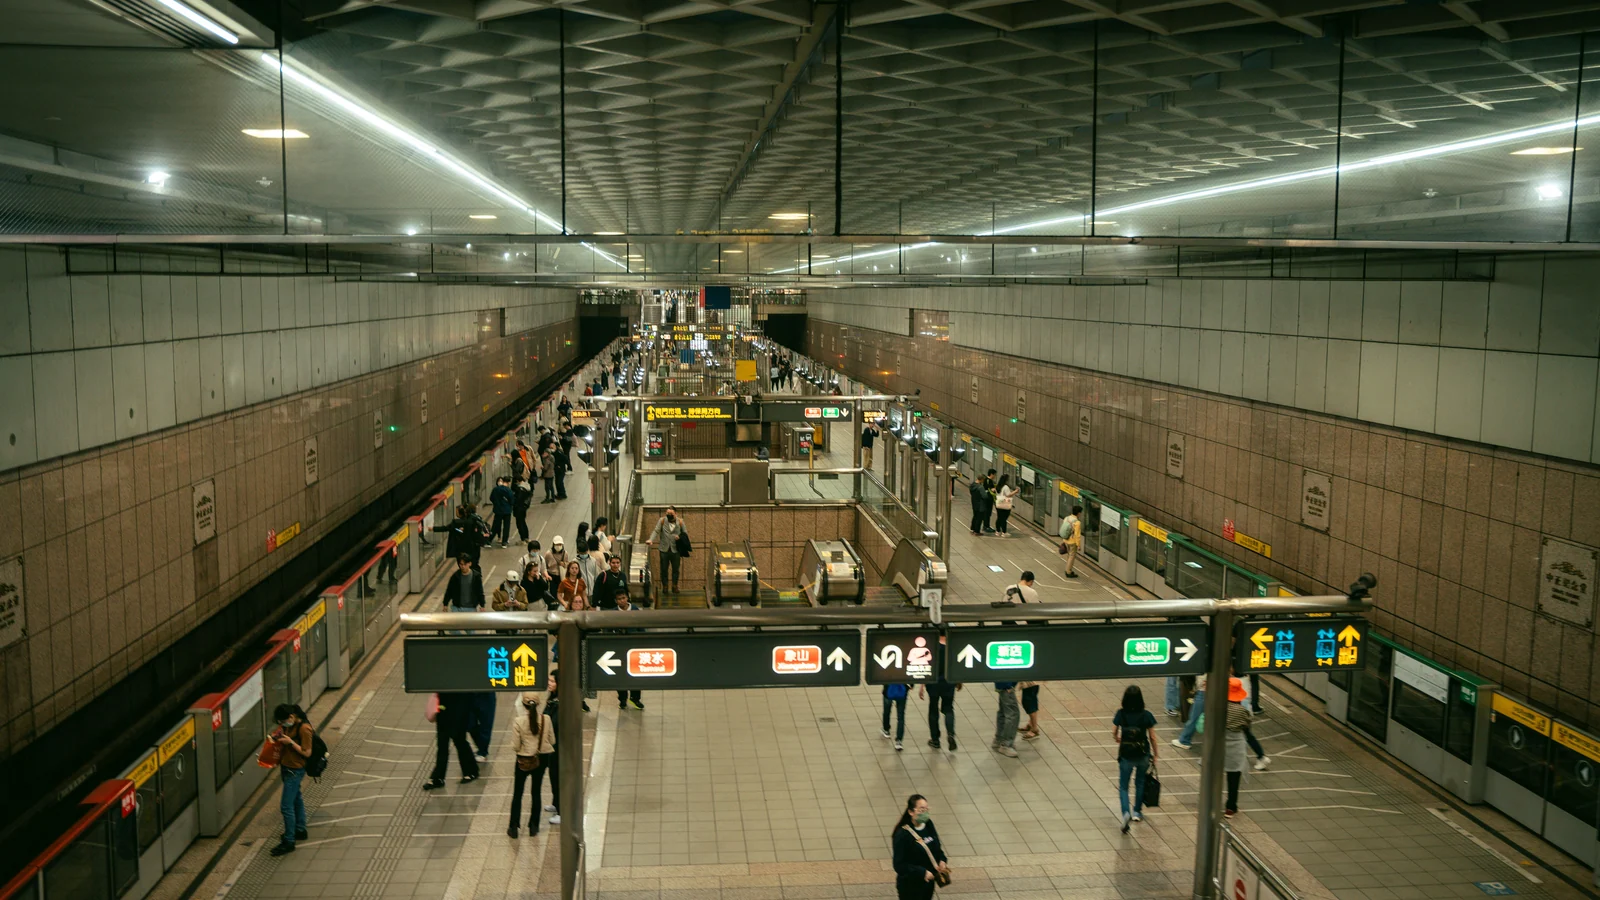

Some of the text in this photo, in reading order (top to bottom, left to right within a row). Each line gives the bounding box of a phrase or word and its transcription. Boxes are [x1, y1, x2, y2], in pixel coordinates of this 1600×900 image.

[997, 644, 1022, 657] 新店
[1134, 641, 1159, 653] 松山
[638, 651, 665, 665] 淡水
[784, 649, 810, 662] 象山
[1129, 653, 1165, 663] Songshan
[1250, 649, 1270, 669] 出口
[1316, 657, 1333, 667] 1-4
[1338, 646, 1358, 666] 出口
[1275, 659, 1292, 668] 5-7
[515, 665, 535, 687] 出口
